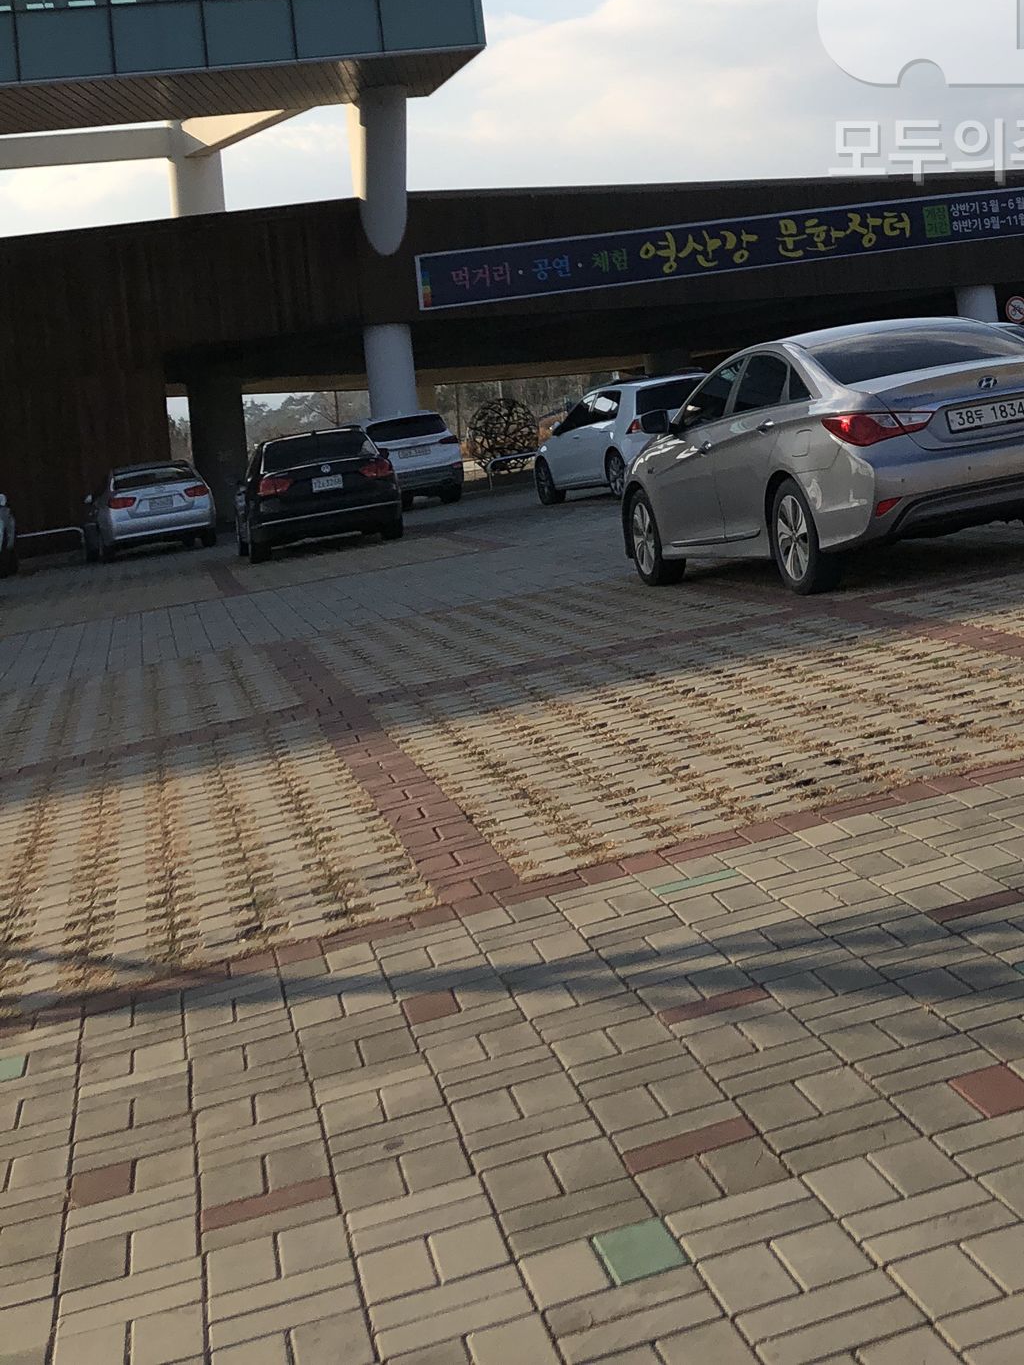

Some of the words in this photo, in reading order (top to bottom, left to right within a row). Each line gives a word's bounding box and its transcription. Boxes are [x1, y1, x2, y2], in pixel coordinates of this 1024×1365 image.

[950, 201, 980, 217] 상반기
[952, 218, 982, 233] 하반기
[640, 231, 758, 273] 영산강
[776, 212, 910, 257] 문화장터
[451, 262, 511, 290] 먹거리
[532, 254, 571, 281] 공연
[591, 249, 629, 273] 체험
